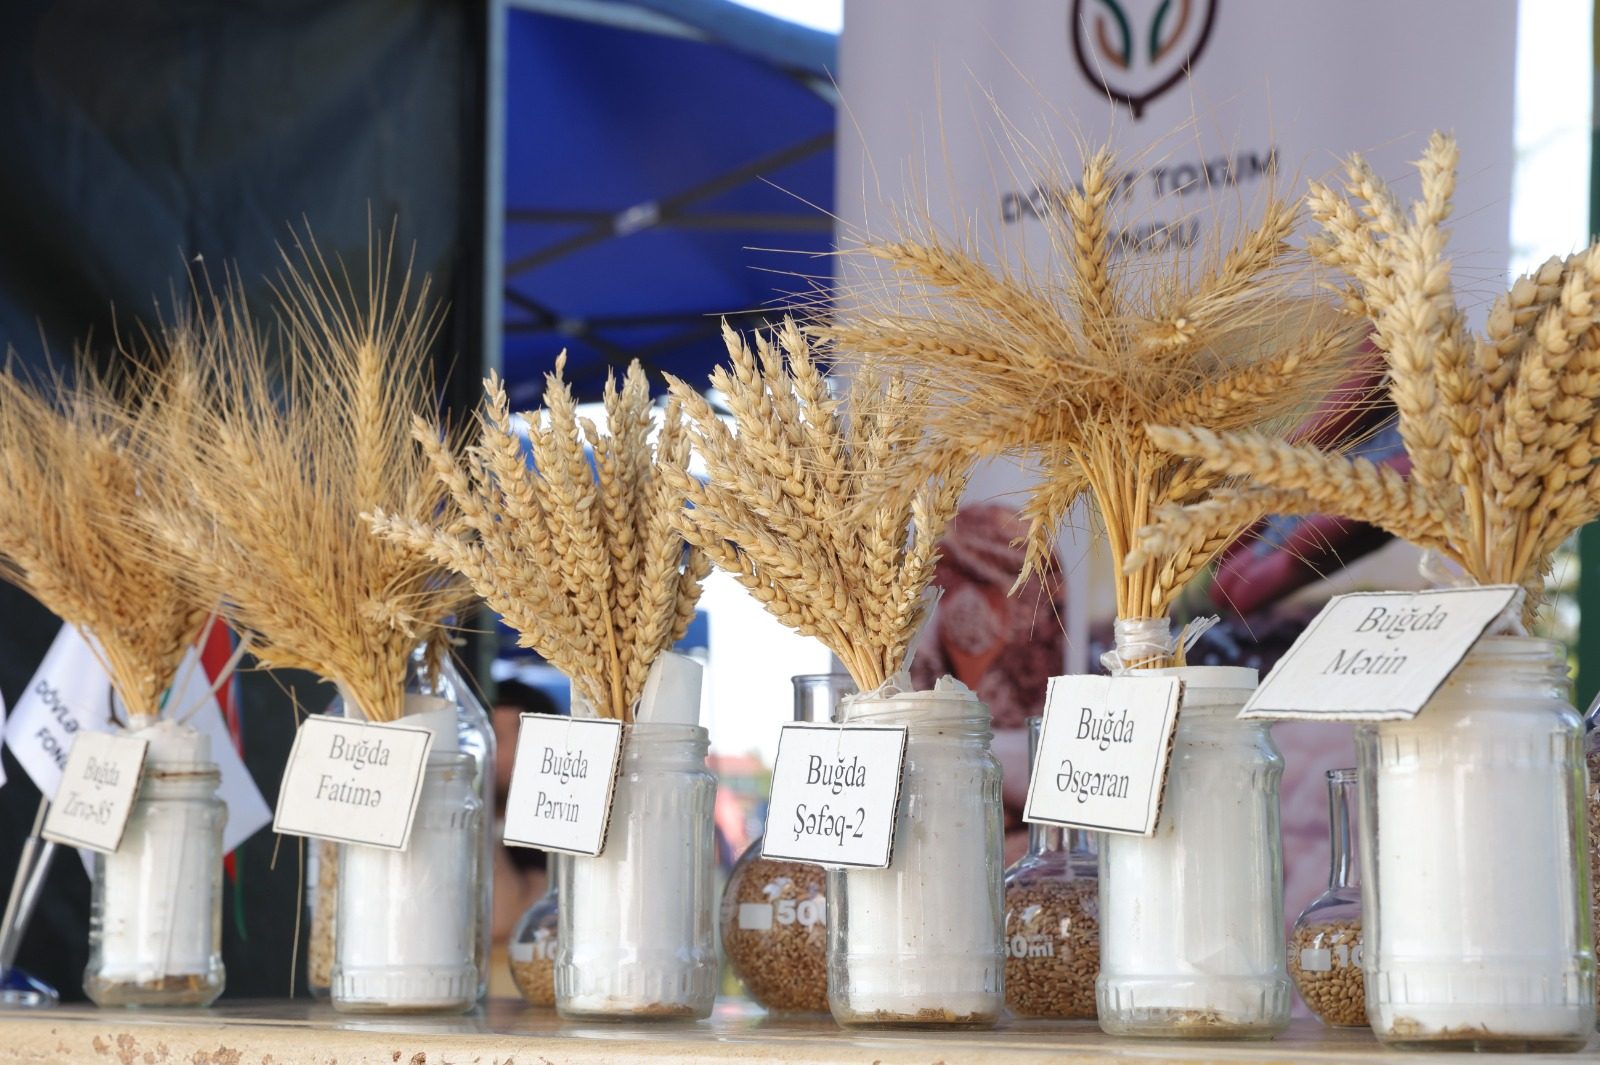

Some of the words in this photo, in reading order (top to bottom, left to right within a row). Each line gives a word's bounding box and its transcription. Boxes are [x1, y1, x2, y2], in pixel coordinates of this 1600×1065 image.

[1353, 604, 1449, 641] Buğda
[1320, 646, 1408, 676] Mətin
[1074, 706, 1135, 752] Buğda
[328, 733, 391, 771] Buğda
[540, 746, 589, 785] Buğda
[315, 773, 382, 808] Fatimə
[805, 754, 867, 796] Buğda
[1056, 759, 1130, 804] Əsgəran
[534, 790, 580, 823] Pərvin
[793, 803, 866, 847] Şəfəq-2
